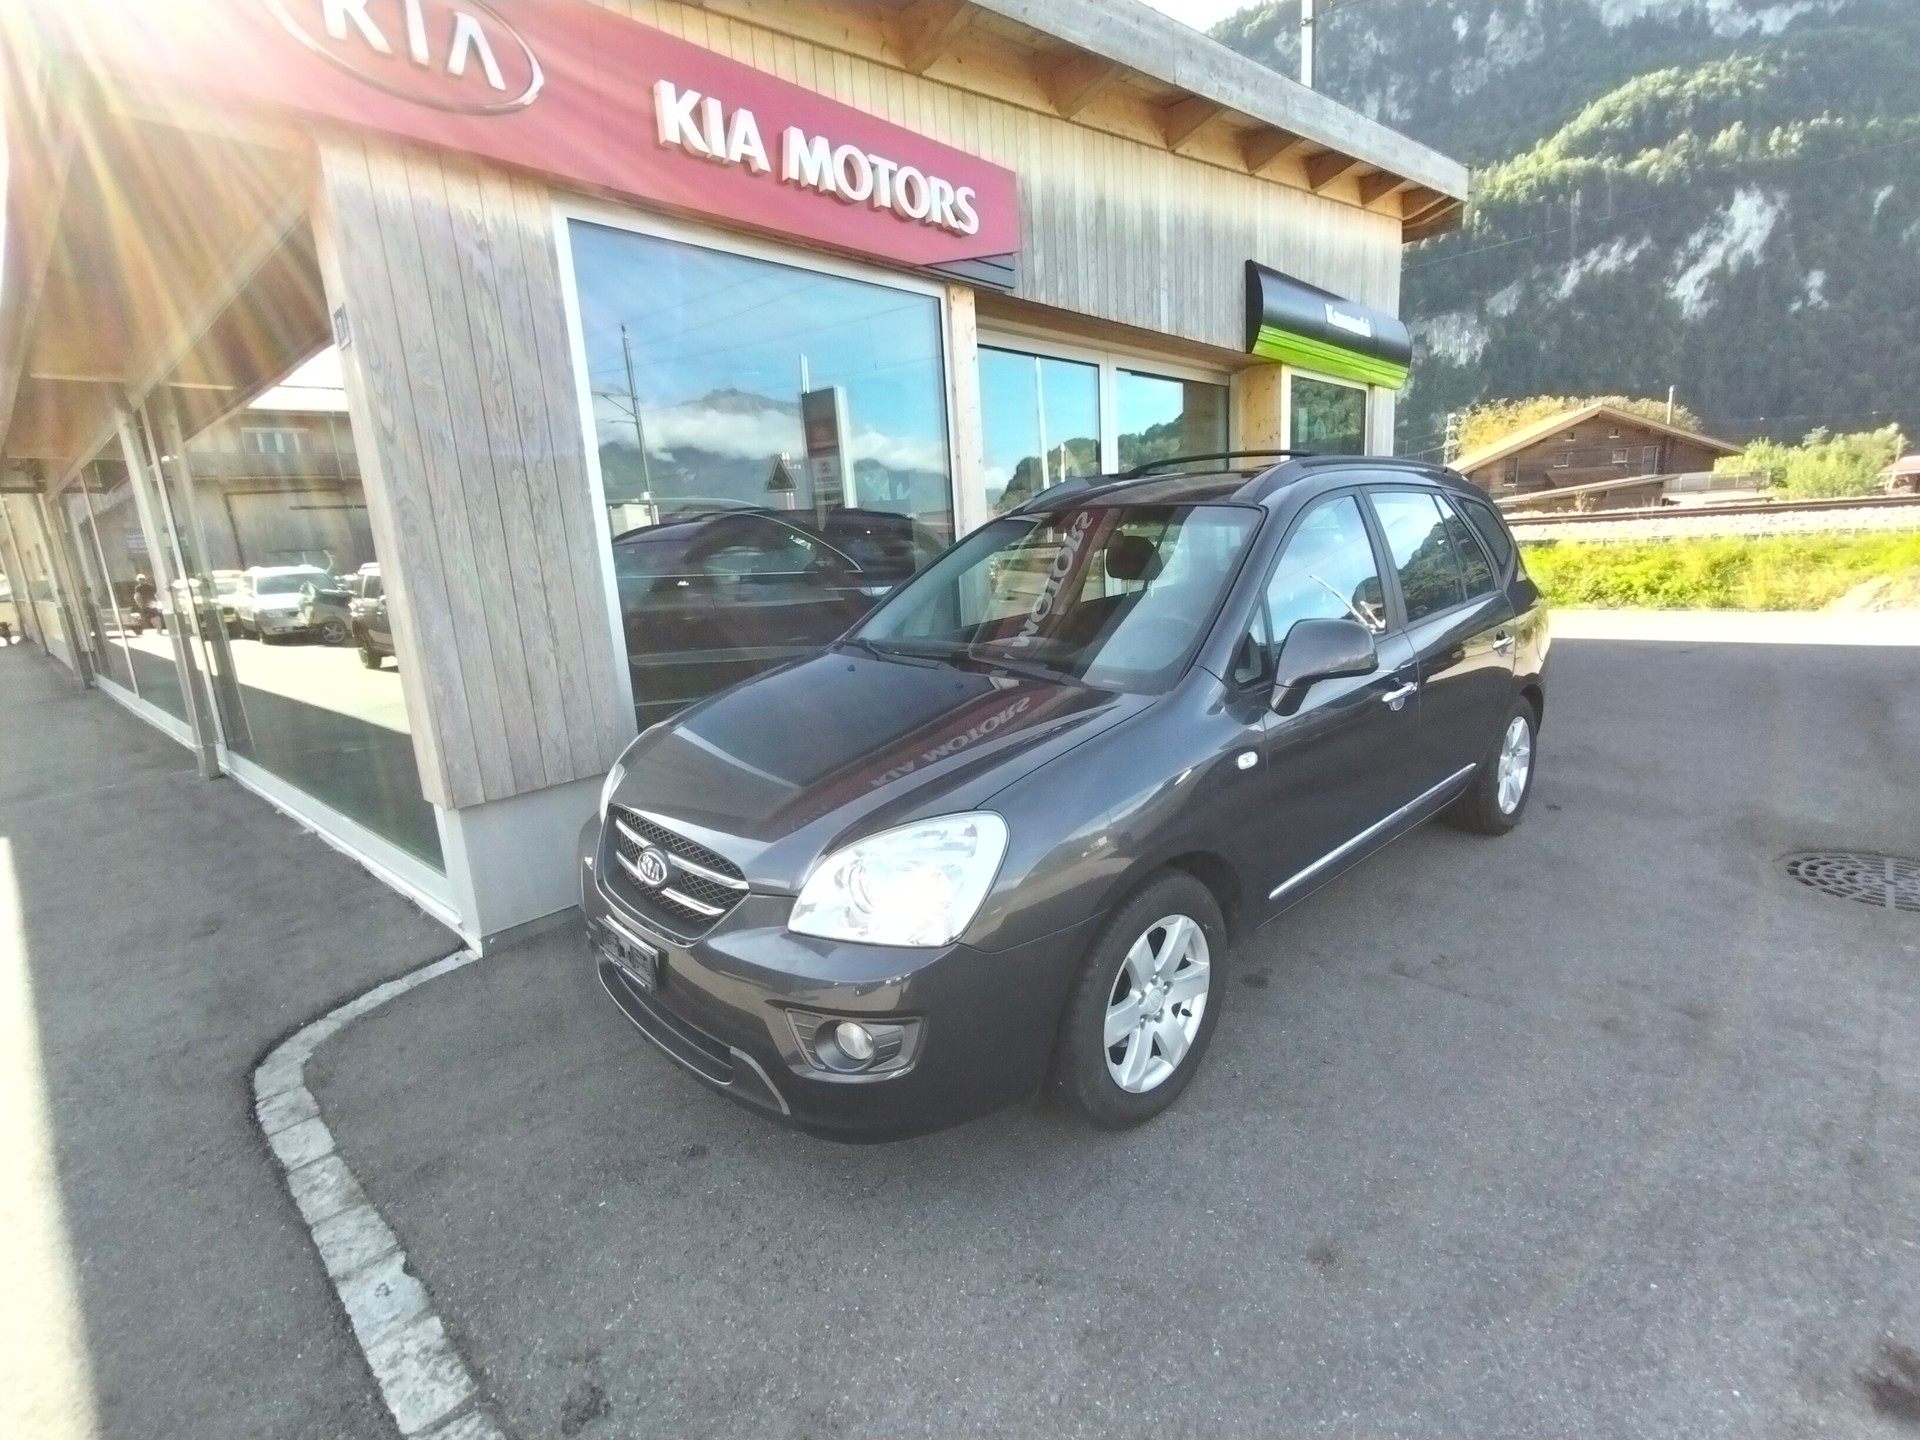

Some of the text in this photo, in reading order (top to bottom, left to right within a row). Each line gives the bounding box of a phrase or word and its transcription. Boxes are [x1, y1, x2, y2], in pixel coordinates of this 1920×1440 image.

[653, 79, 979, 236] KIA MOTORS
[641, 853, 661, 881] KIA
